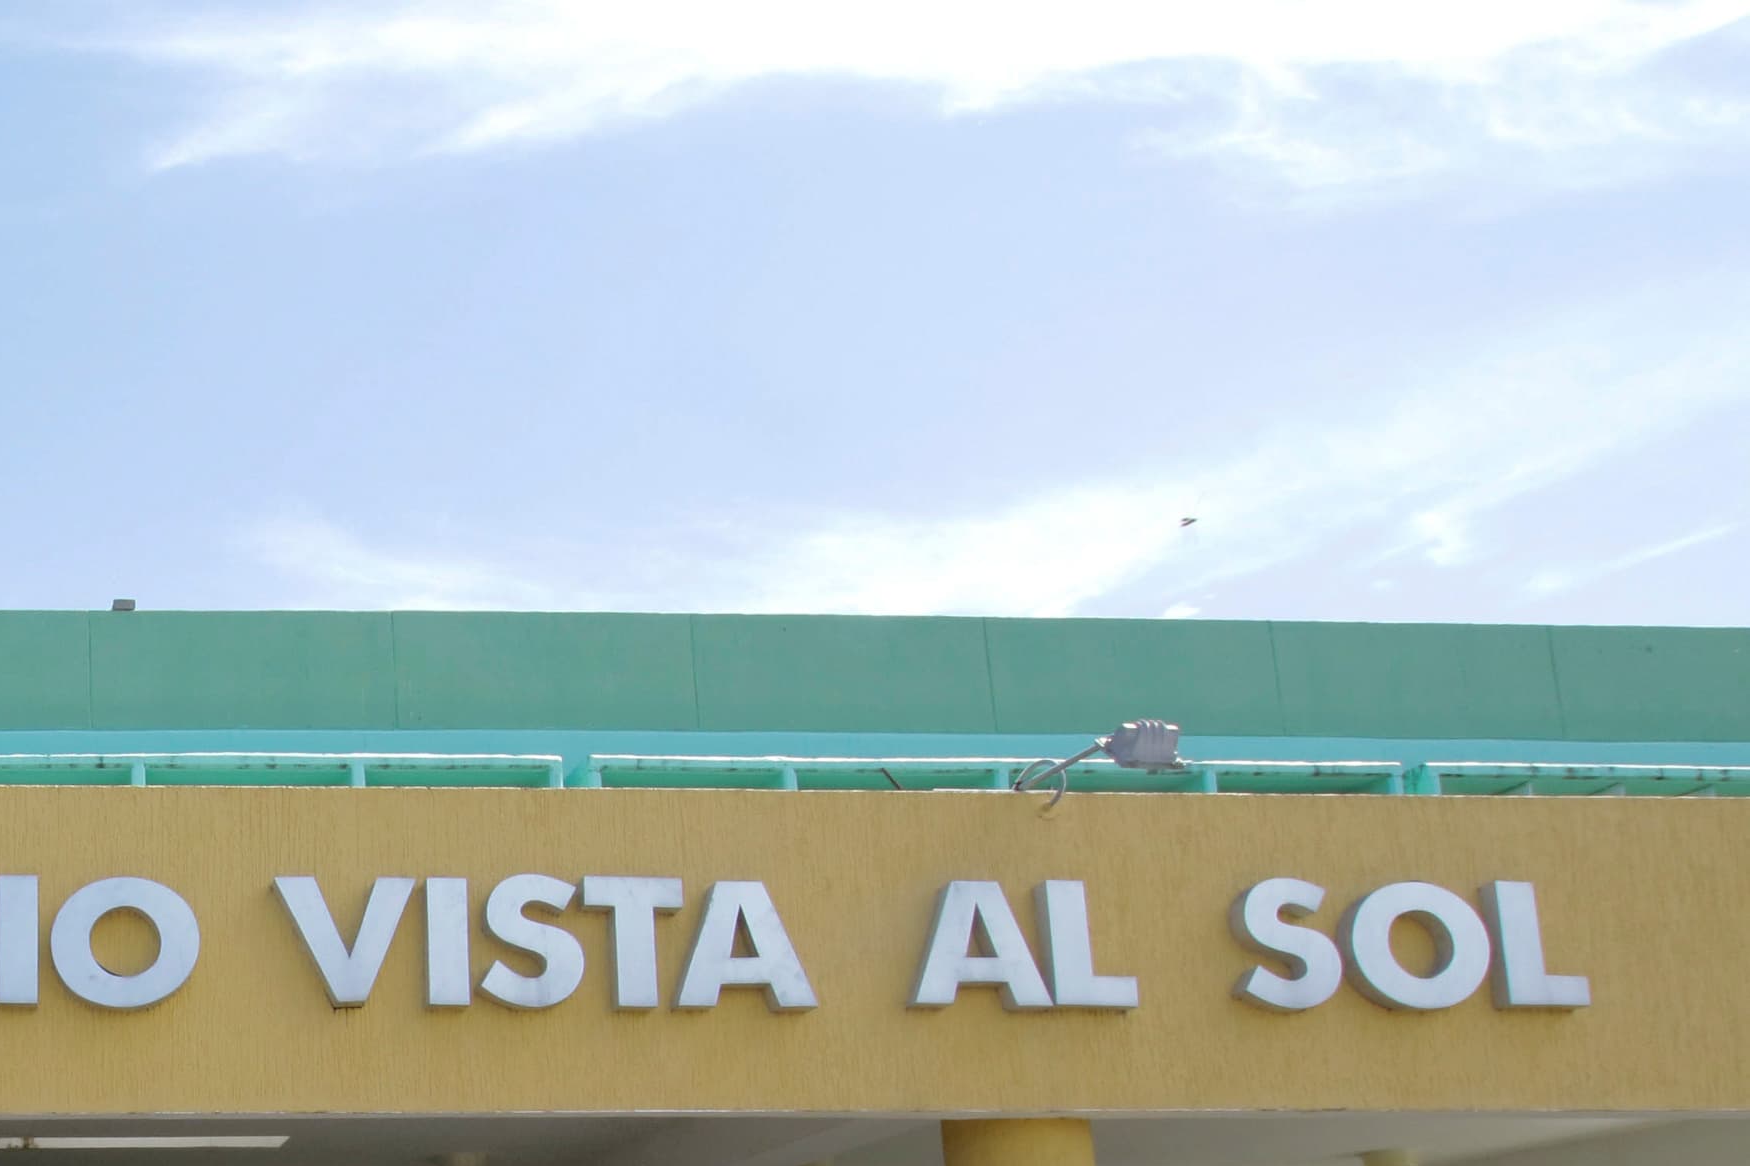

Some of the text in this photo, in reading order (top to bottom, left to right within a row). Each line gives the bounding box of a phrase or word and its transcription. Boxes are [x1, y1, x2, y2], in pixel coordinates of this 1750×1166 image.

[272, 872, 819, 1011] VISTA
[905, 878, 1140, 1010] AL
[1234, 876, 1592, 1012] SOL
